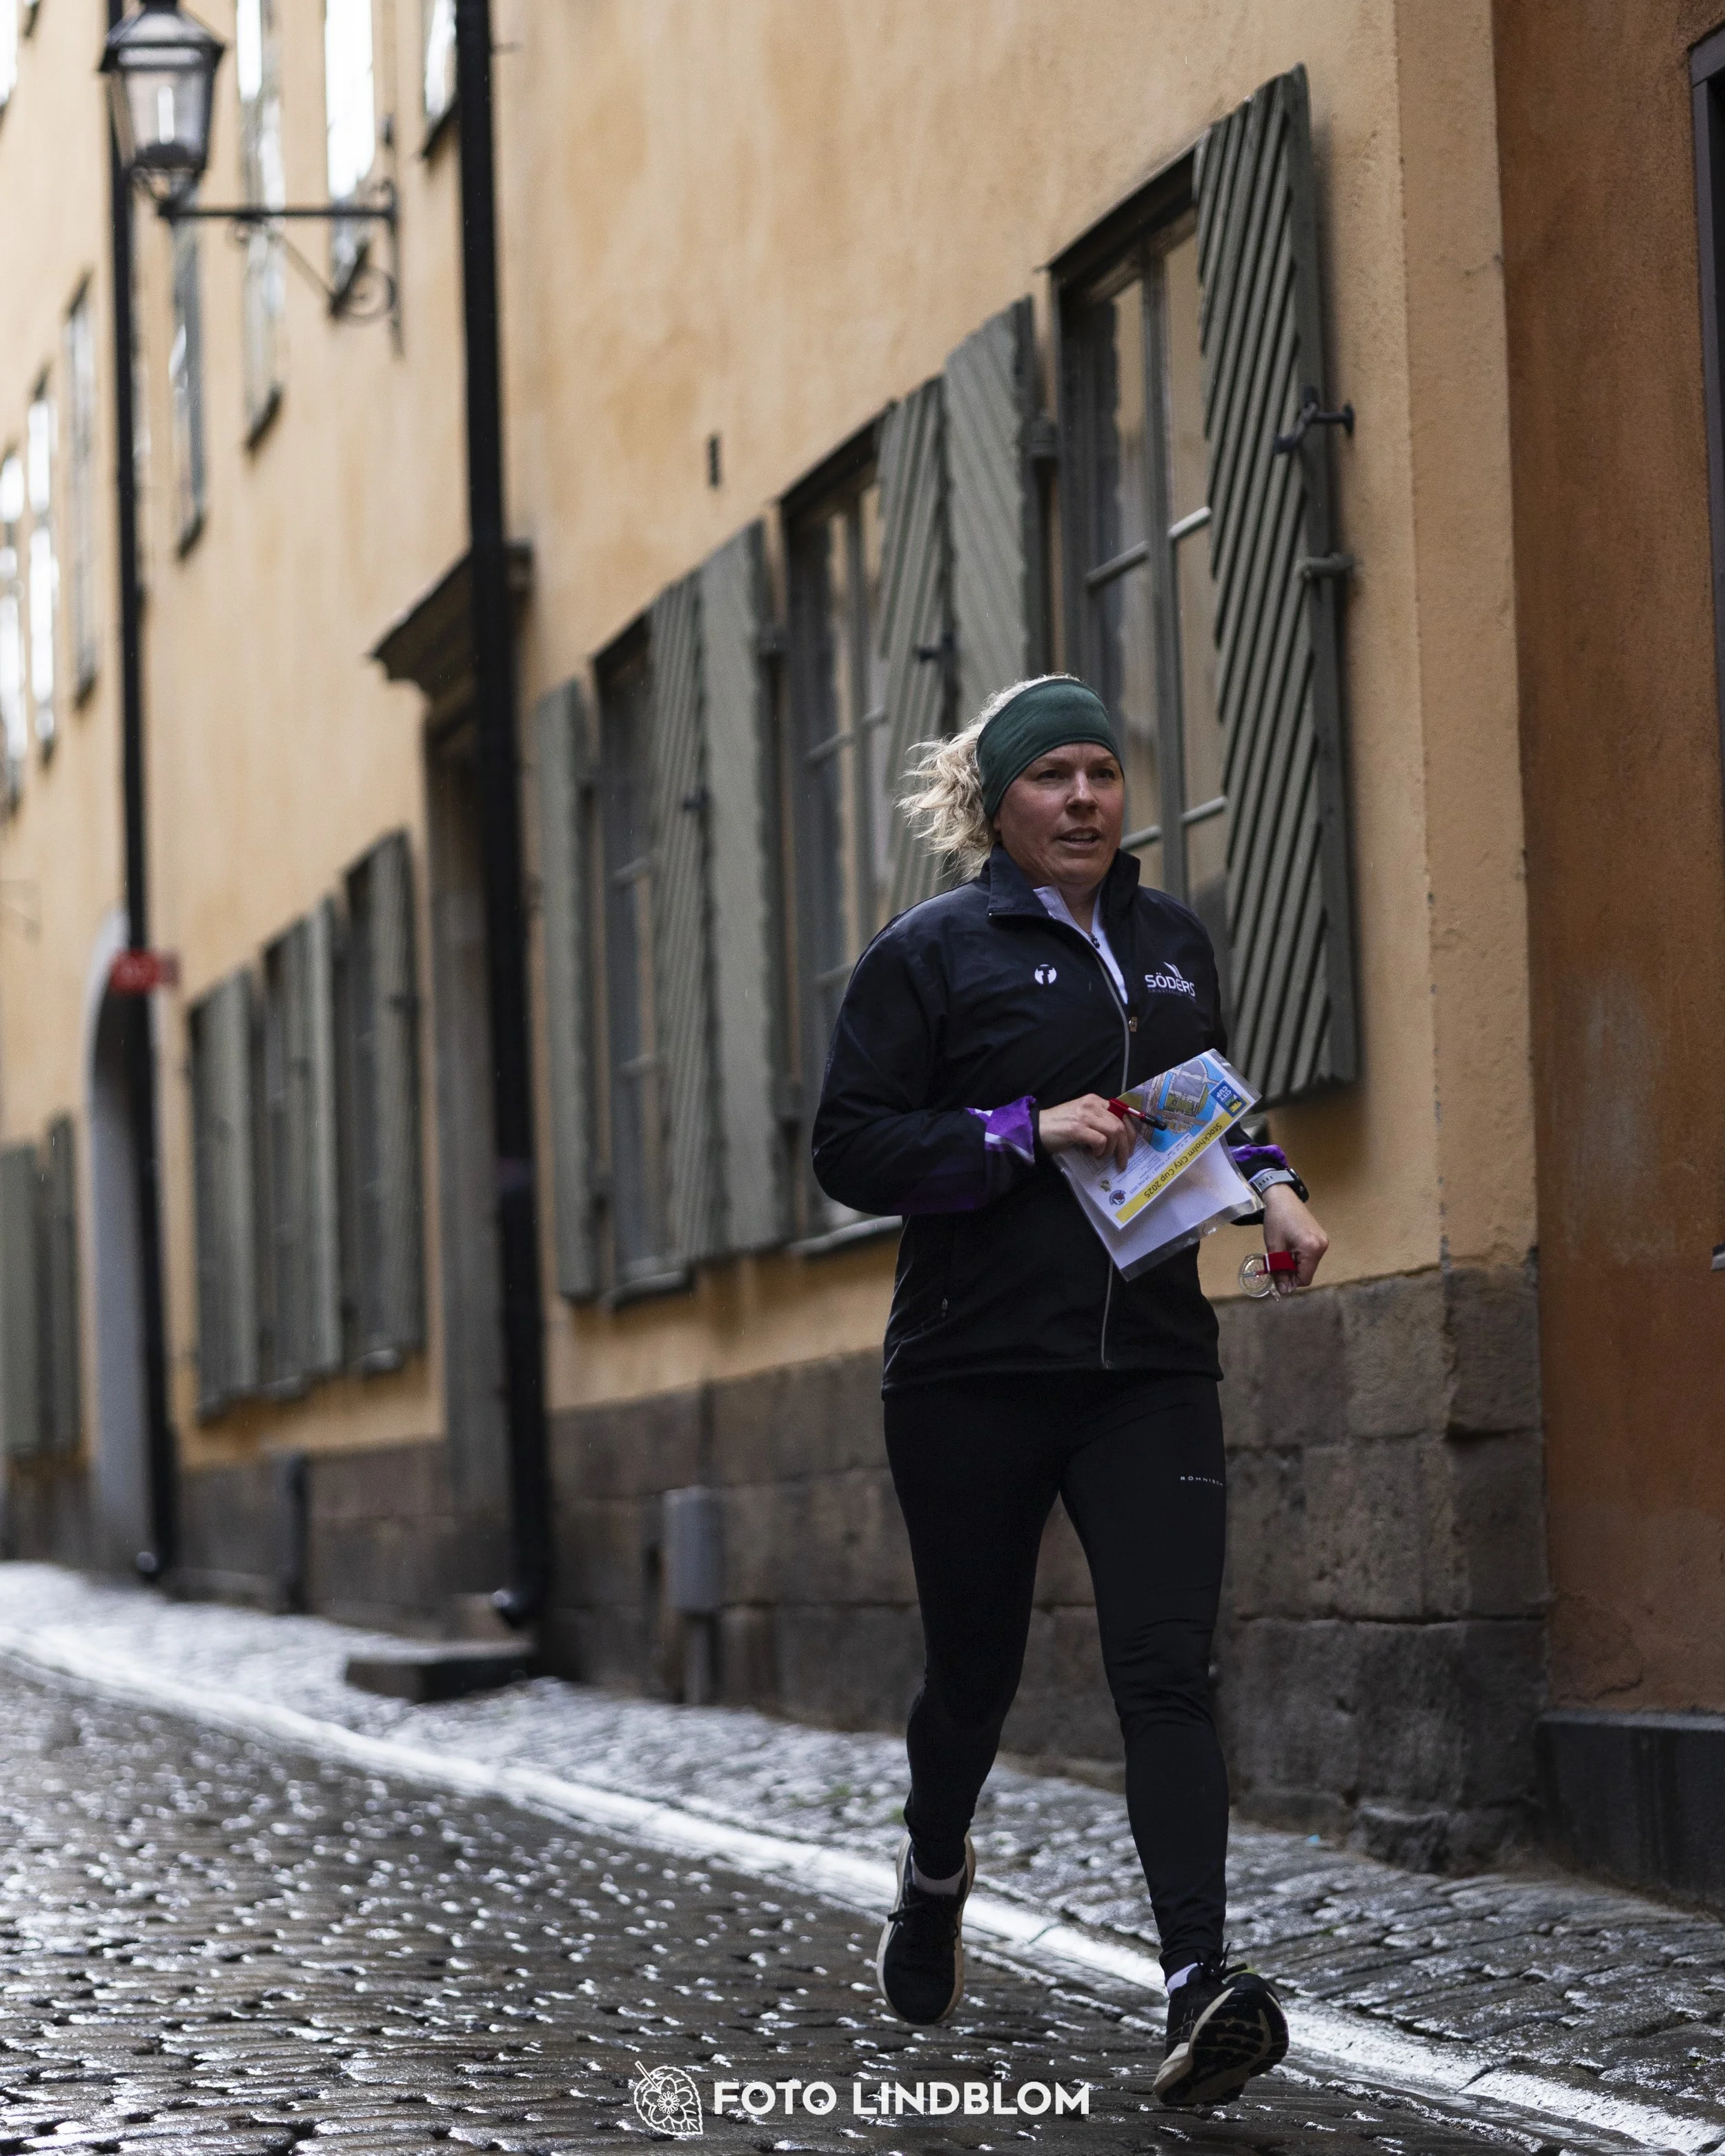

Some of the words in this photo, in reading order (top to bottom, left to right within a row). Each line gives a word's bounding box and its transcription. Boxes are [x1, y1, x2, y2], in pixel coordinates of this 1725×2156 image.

[1144, 971, 1196, 997] SÖDERS
[1216, 1085, 1228, 1098] CUP
[1220, 1089, 1232, 1102] CITY
[1187, 1122, 1223, 1156] Stockholm
[1173, 1155, 1188, 1169] City
[1159, 1167, 1174, 1182] Cup
[1143, 1180, 1161, 1198] 2025
